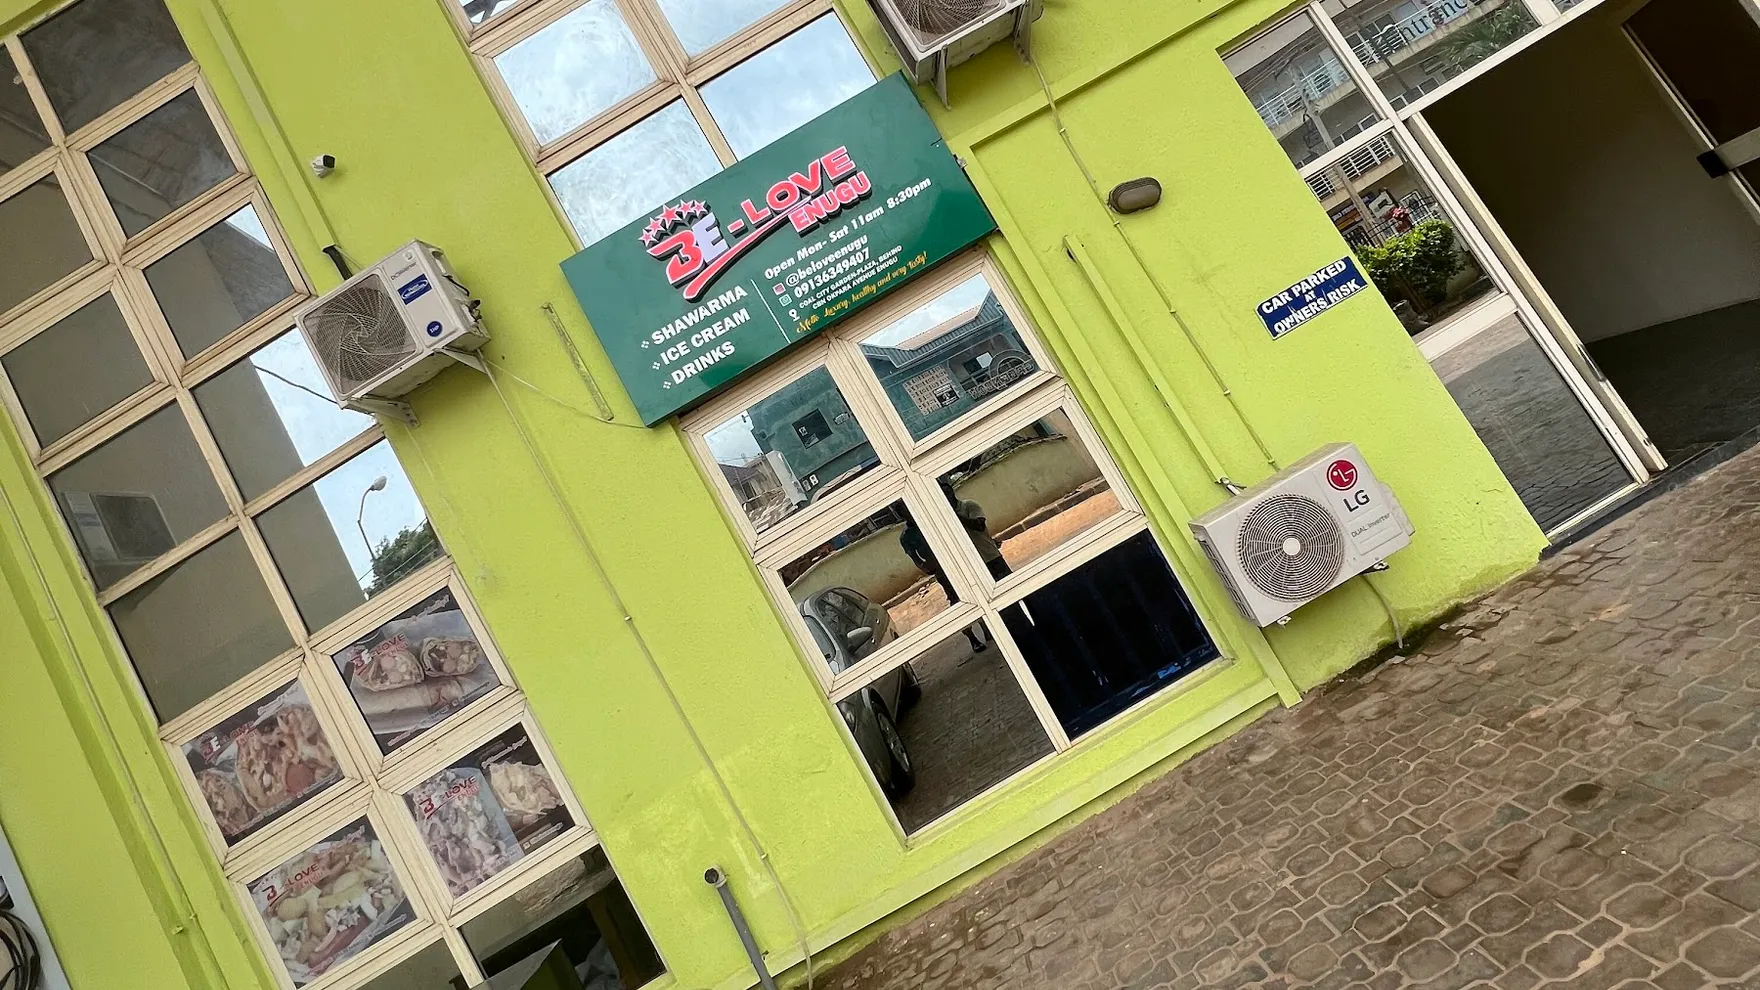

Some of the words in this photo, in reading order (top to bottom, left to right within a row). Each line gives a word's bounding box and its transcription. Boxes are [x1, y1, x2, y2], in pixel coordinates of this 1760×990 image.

[765, 256, 795, 279] Open
[829, 225, 849, 243] Sat
[851, 206, 884, 230] 11am
[887, 177, 931, 209] 8:30pm
[788, 170, 872, 233] ENUGU
[786, 235, 868, 287] @beloveenugu
[794, 247, 870, 298] 09136349407
[800, 296, 816, 309] COAL
[816, 288, 830, 301] CITY
[879, 245, 902, 262] BEHIND
[812, 299, 827, 310] CBN
[827, 285, 852, 301] OKPARA
[852, 270, 877, 288] AVENUE
[876, 257, 898, 273] ENUGU
[852, 284, 877, 303] healthy
[877, 272, 891, 287] and
[891, 264, 907, 279] very
[1262, 291, 1293, 314] CAR
[1290, 260, 1347, 298] PARKED
[651, 285, 748, 345] SHAWARMA
[1274, 297, 1328, 334] OWNERS
[1327, 278, 1360, 304] RISK
[1304, 290, 1316, 302] AT
[660, 341, 691, 365] ICE
[691, 307, 751, 348] CREAM
[671, 341, 735, 385] DRINKS
[1343, 489, 1370, 512] LG
[1351, 525, 1368, 538] DUAL
[1368, 513, 1390, 529] Inverter
